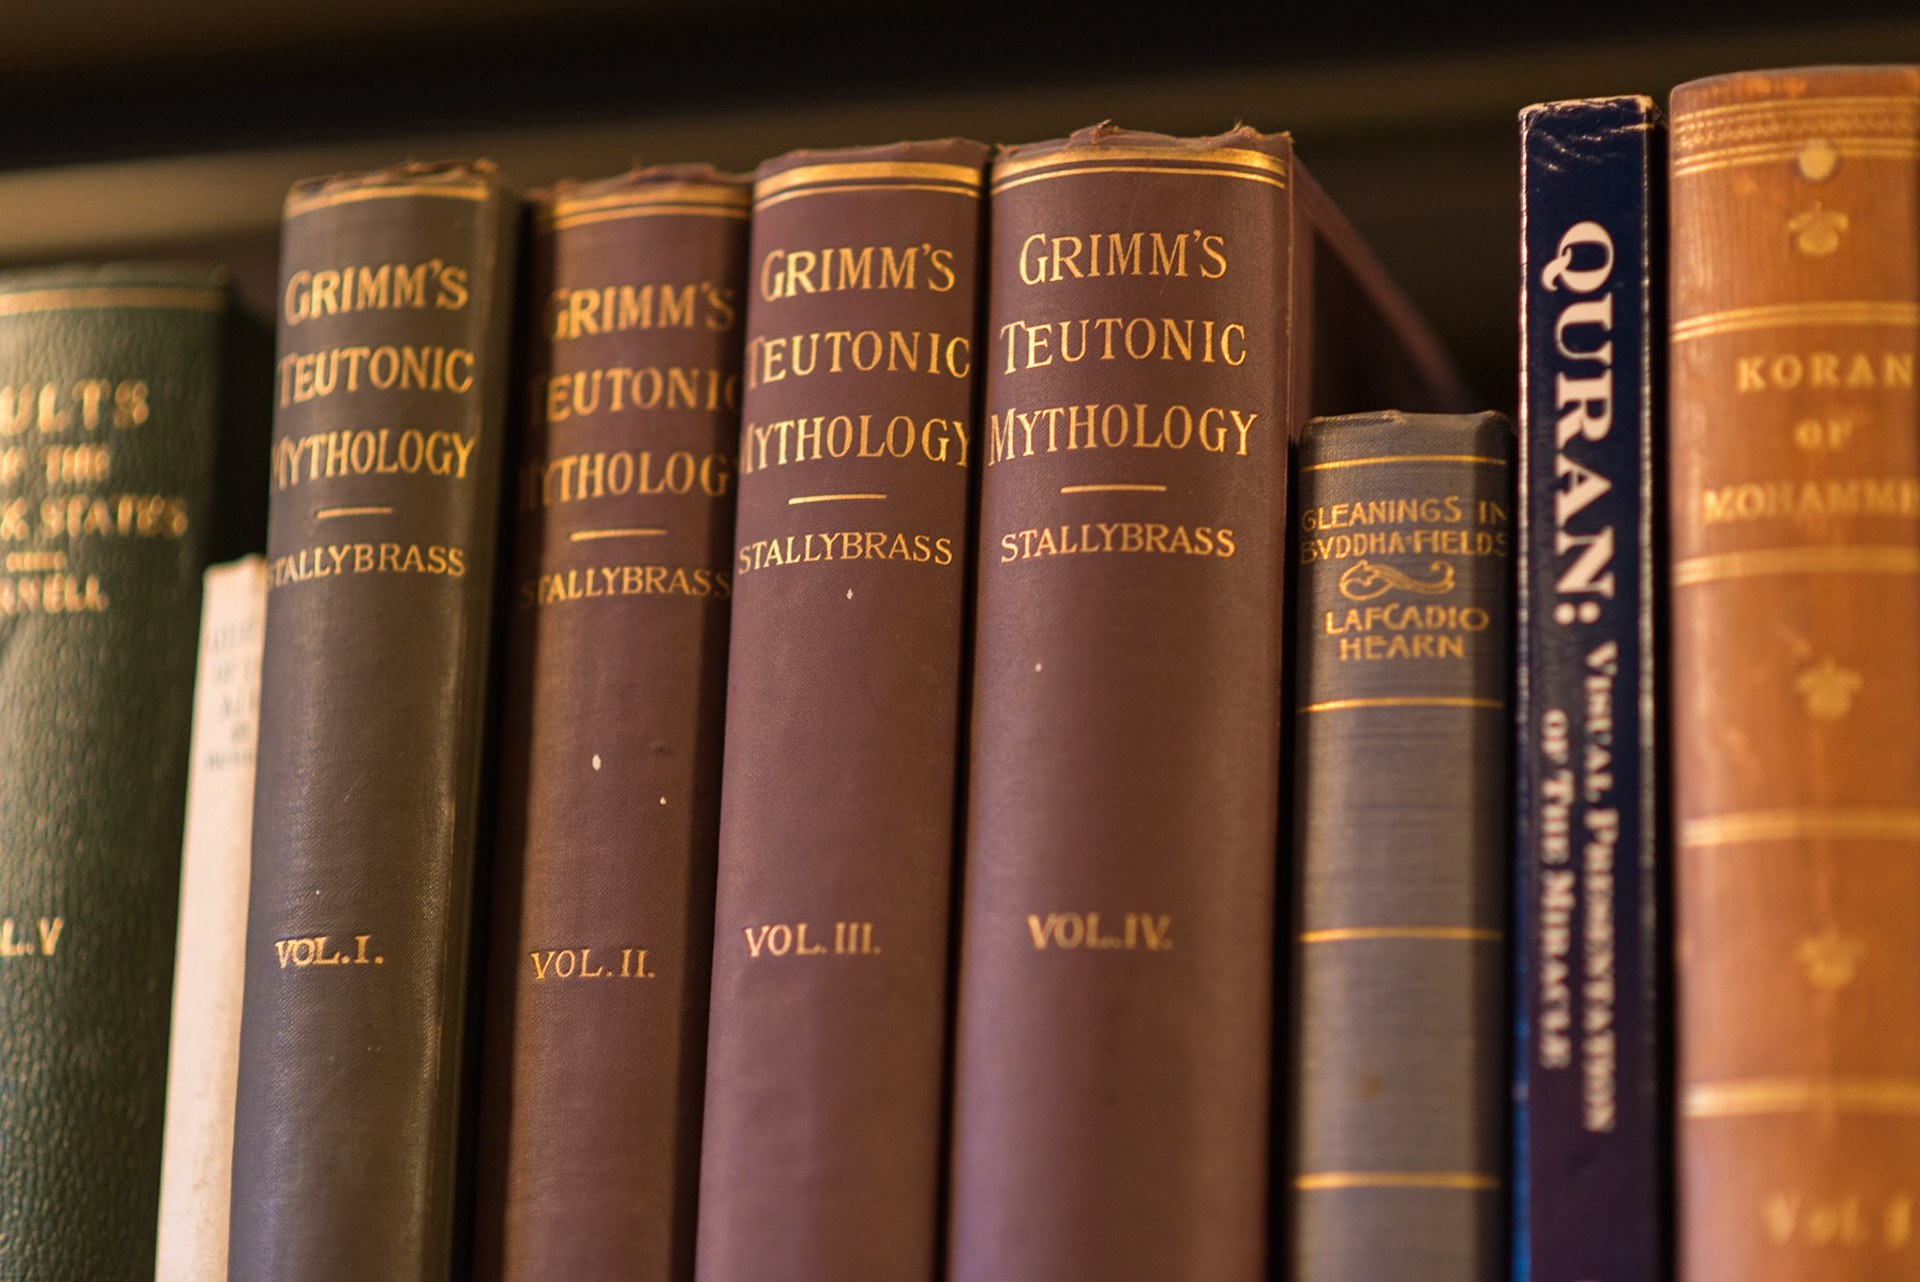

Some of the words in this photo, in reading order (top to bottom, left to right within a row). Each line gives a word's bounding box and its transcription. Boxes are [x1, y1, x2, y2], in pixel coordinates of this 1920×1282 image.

[760, 243, 956, 302] GRIMM'S
[1018, 229, 1228, 286] GRIMM'S
[284, 258, 469, 327] GRIMM'S
[546, 281, 736, 341] GRIMM'S
[747, 330, 971, 390] TEUTONIC
[1000, 317, 1247, 375] TEUTONIC
[278, 346, 475, 409] TEUTONIC
[1735, 352, 1914, 393] KORAN
[988, 403, 1258, 466] MYTHOLOGY
[1540, 220, 1616, 626] QURAN:
[519, 451, 738, 510] MYTHOLOG
[1302, 495, 1463, 532] GLEANINGS
[1478, 500, 1508, 525] IN
[738, 532, 953, 575] STALLYBRASS
[1001, 522, 1236, 563] STALLYBRASS
[1324, 602, 1490, 635] LAFCADIO
[1338, 634, 1464, 662] HEARN
[38, 916, 64, 956] V
[275, 936, 351, 969] VOL.
[354, 934, 384, 965] I.
[745, 921, 827, 957] VOL.
[834, 921, 881, 955] III.
[1028, 911, 1121, 950] VOL.
[1124, 912, 1173, 950] IV.
[530, 948, 612, 979] VOL.
[619, 948, 655, 978] II.
